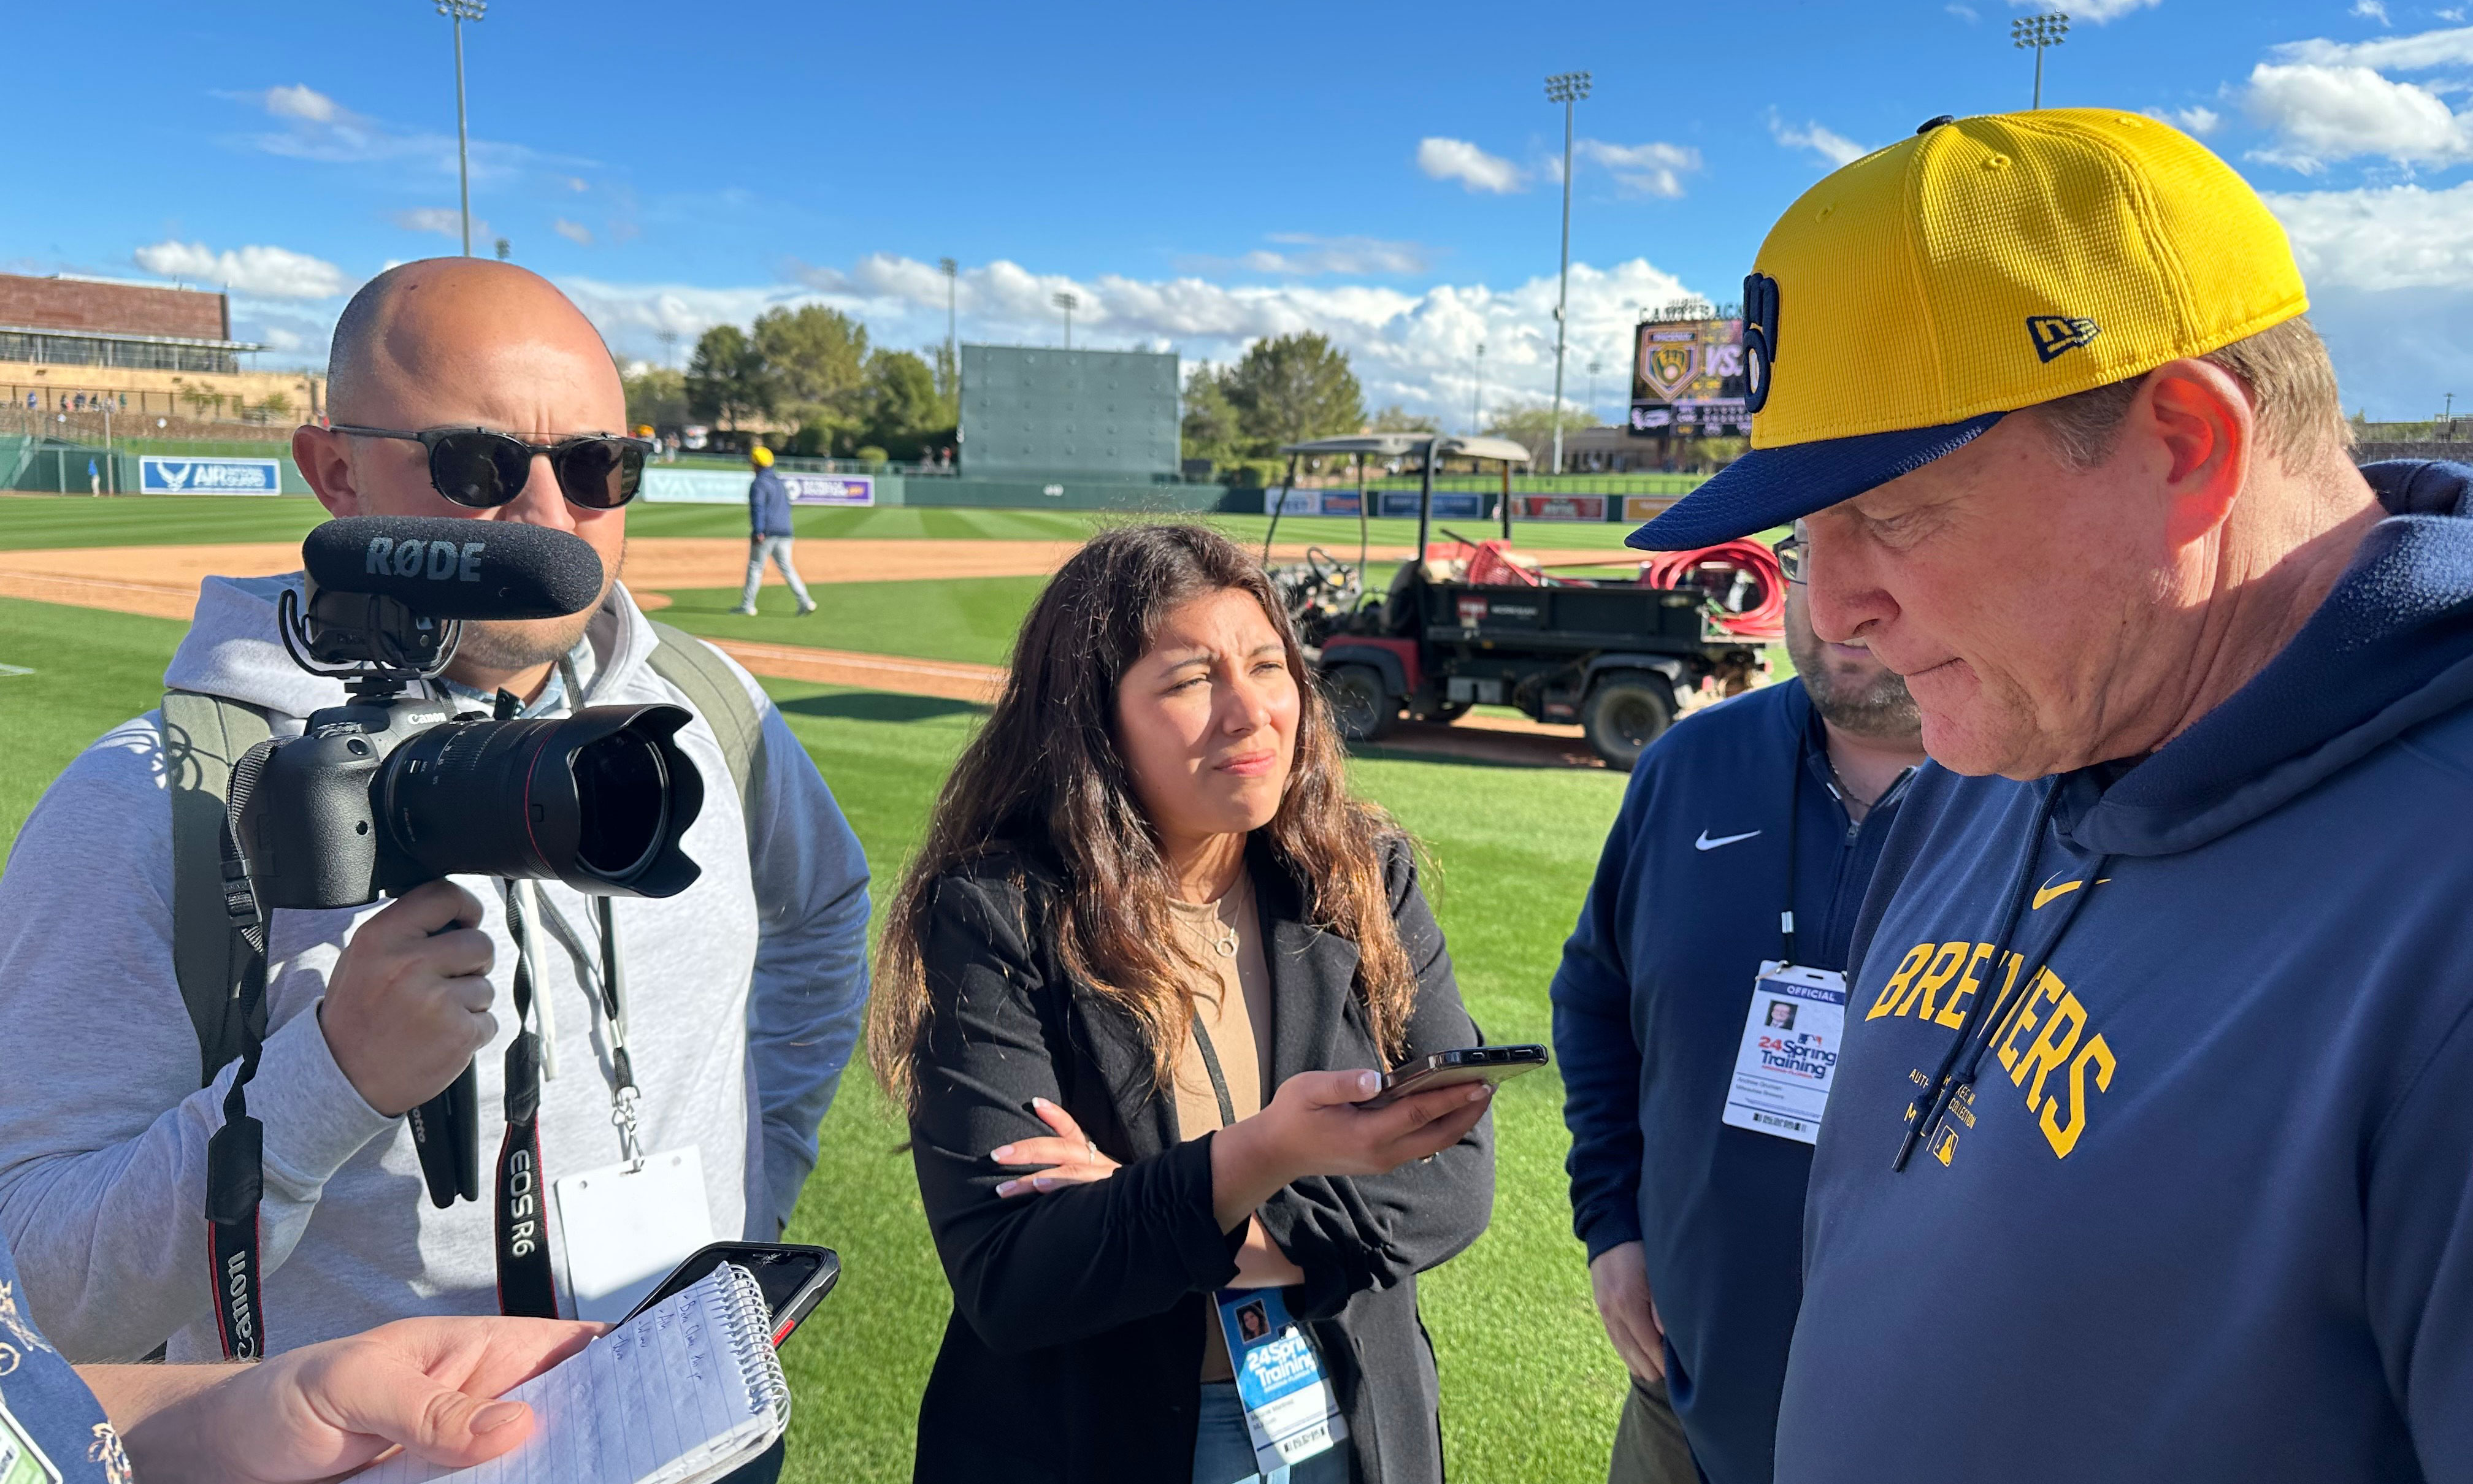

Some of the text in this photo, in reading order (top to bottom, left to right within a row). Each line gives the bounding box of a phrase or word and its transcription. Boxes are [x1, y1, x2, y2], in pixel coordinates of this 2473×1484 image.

[193, 464, 227, 486] AIR
[366, 537, 486, 582] RØDE
[408, 712, 447, 725] Canon
[1787, 985, 1835, 1002] OFFICIAL
[1762, 1049, 1826, 1079] Training
[510, 1149, 535, 1257] EOS R6
[228, 1250, 255, 1361] Canon
